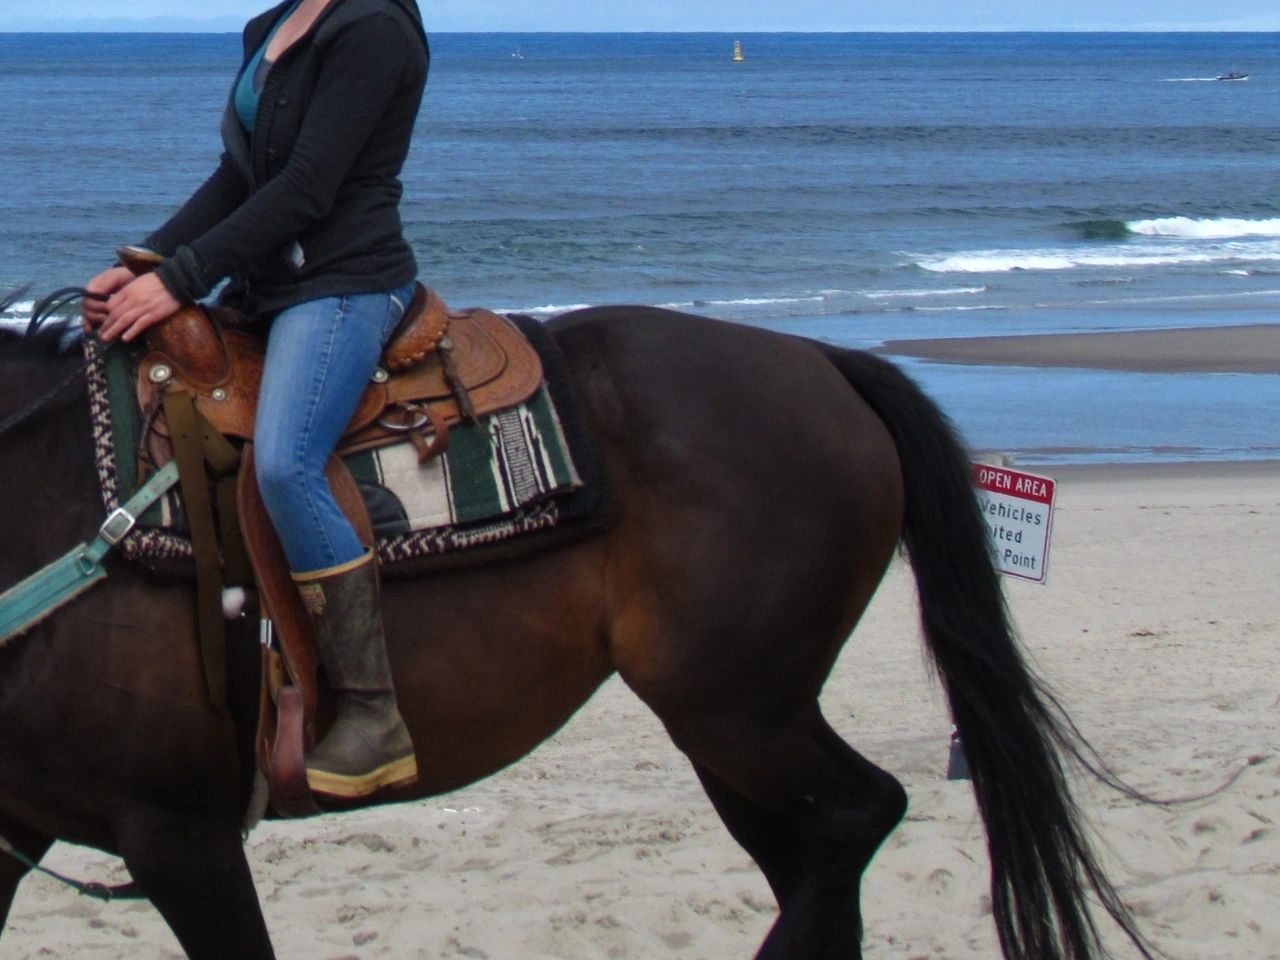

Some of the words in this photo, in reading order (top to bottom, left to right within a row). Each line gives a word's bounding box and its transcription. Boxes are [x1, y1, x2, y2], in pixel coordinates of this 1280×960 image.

[980, 469, 1011, 489] OPEN
[1016, 478, 1047, 497] AREA
[981, 498, 1041, 525] Vehicles
[992, 524, 1023, 544] ited
[1004, 548, 1036, 569] Point
